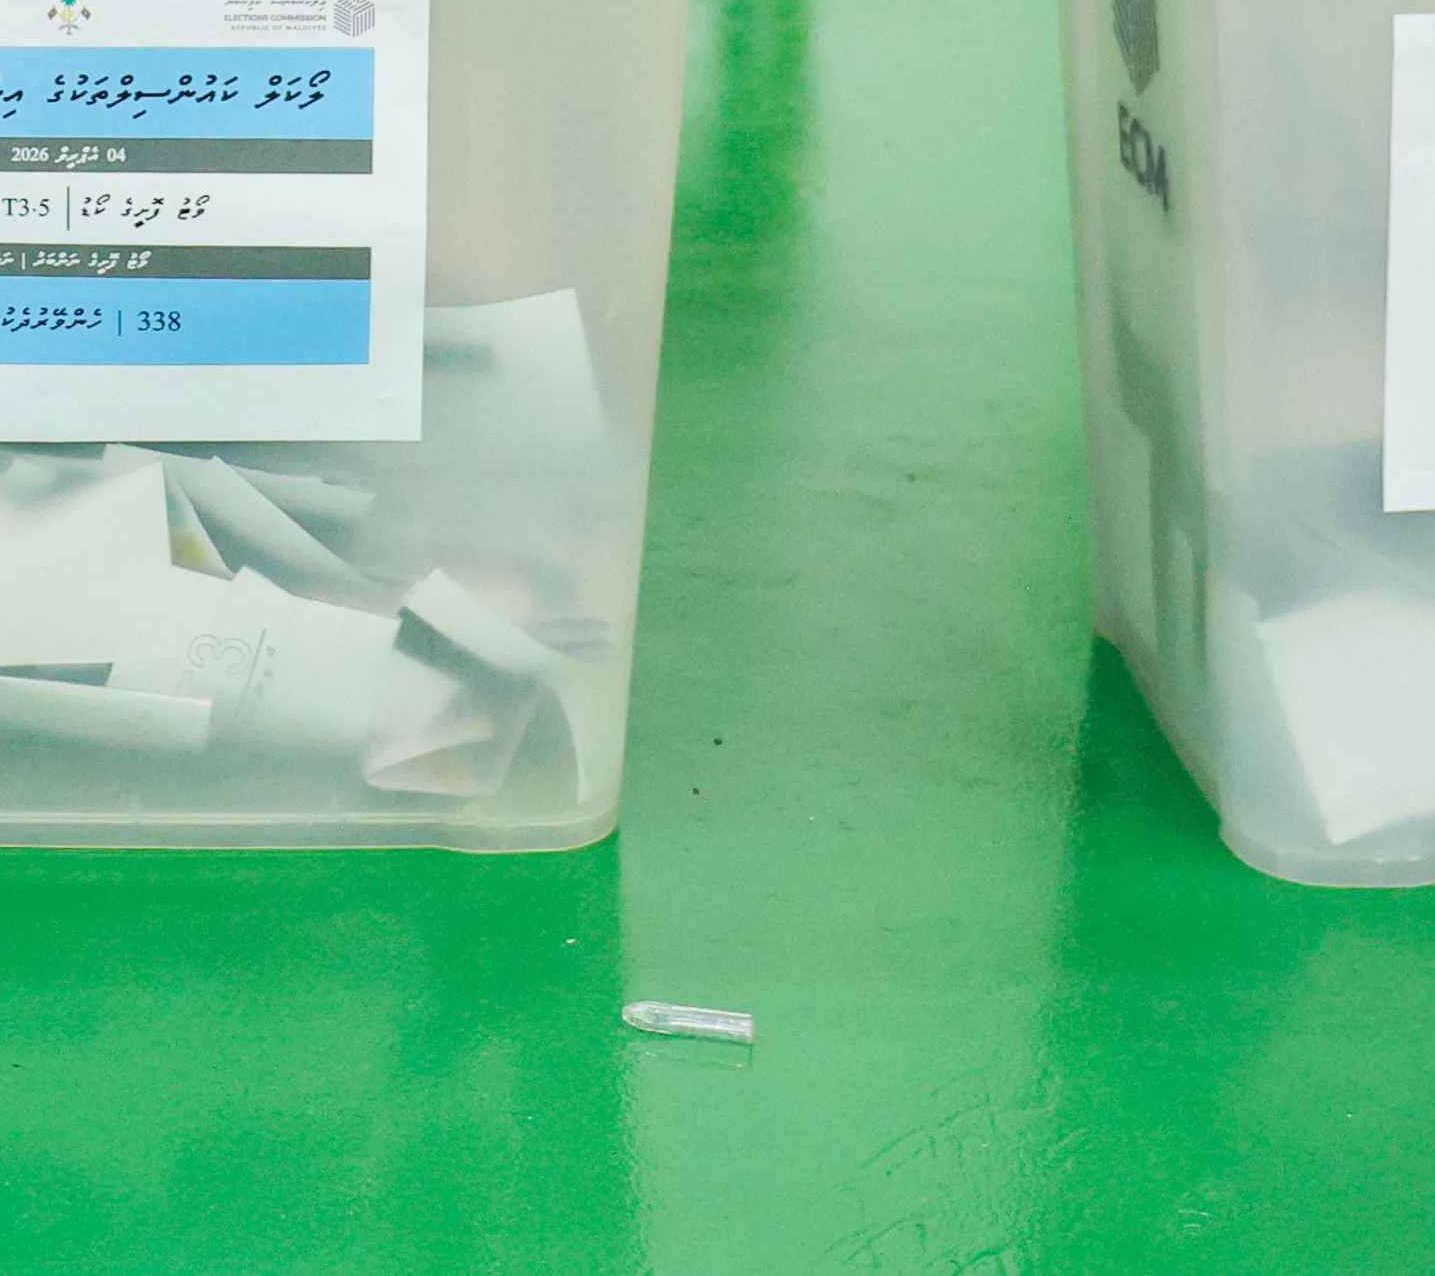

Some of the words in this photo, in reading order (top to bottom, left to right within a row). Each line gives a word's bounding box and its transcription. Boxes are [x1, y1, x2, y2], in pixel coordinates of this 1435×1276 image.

[224, 14, 269, 22] ELECTIONS
[271, 14, 327, 22] COMMISSION
[47, 74, 239, 119] ކައުންސިލްތަކުގެ
[254, 70, 331, 109] ލޯކަލް
[11, 146, 49, 162] 2026
[106, 147, 127, 163] 04
[137, 311, 181, 332] 338
